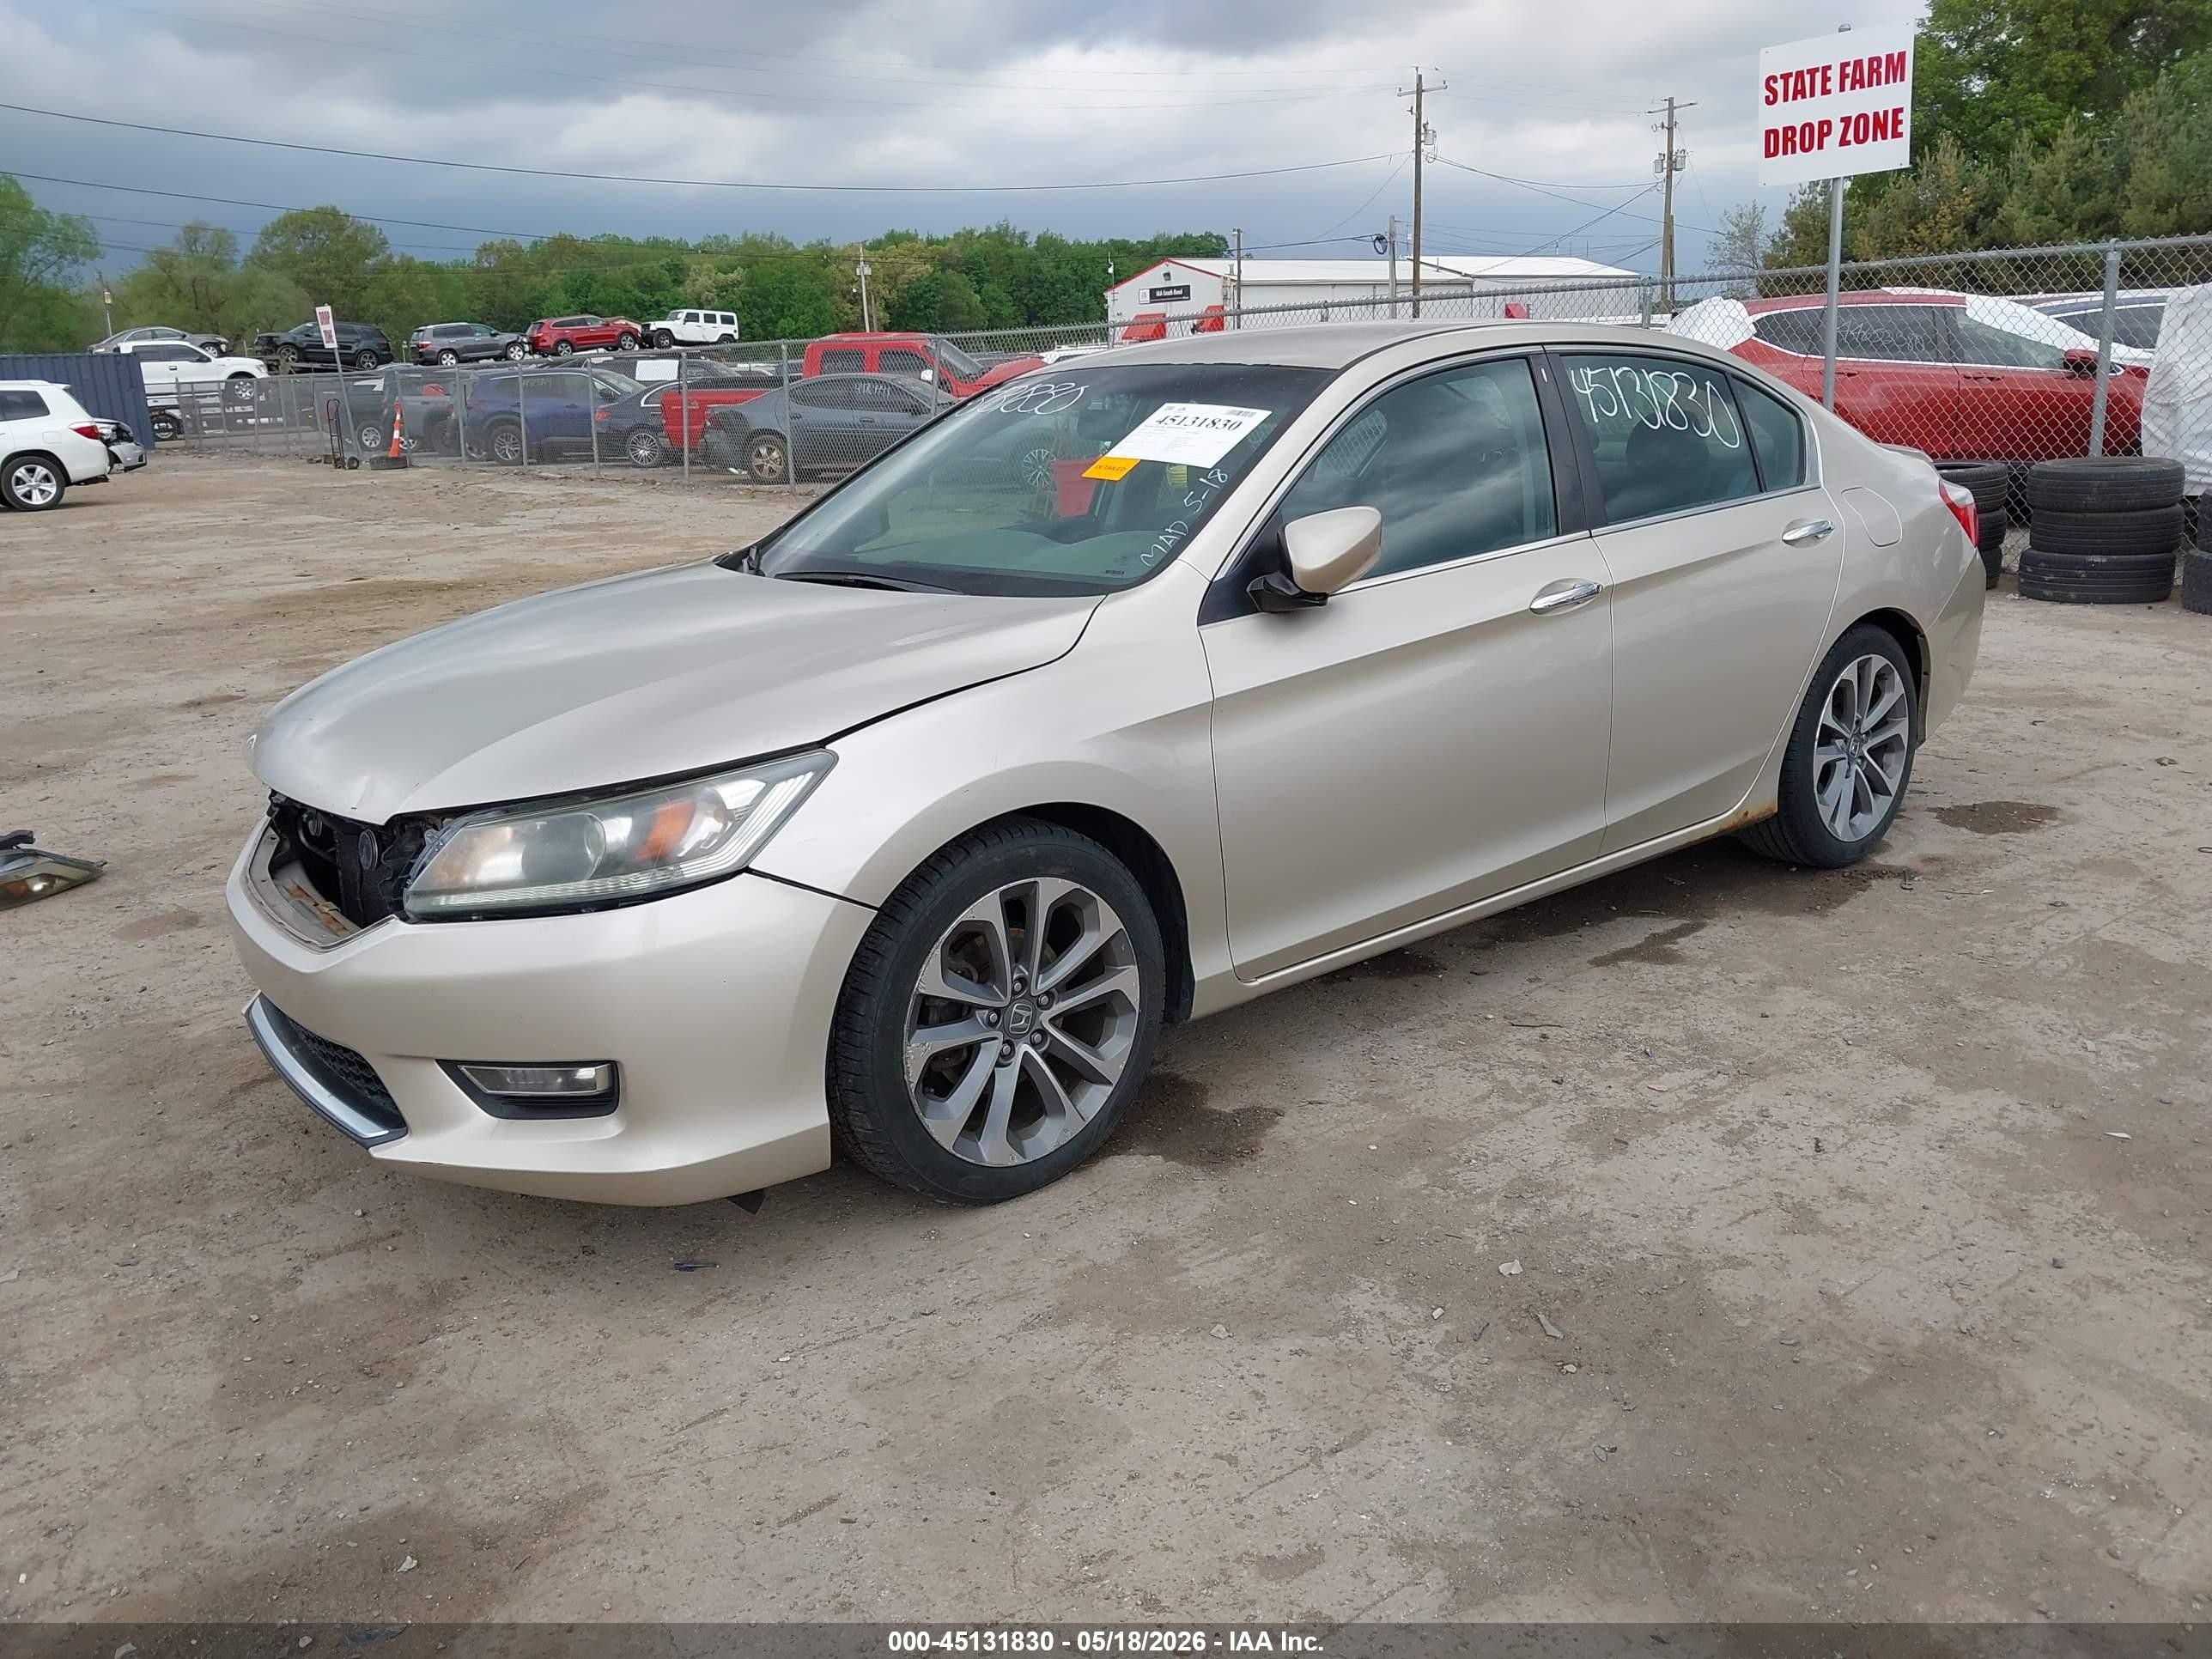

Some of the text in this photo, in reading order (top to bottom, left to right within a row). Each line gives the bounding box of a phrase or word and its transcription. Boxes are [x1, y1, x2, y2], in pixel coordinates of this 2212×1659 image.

[1765, 51, 1907, 106] STATE FARM
[1764, 106, 1905, 158] DROP ZONE
[1156, 415, 1243, 430] 45131830
[1569, 366, 1740, 447] 45131830
[1140, 468, 1228, 567] MAD 5-18
